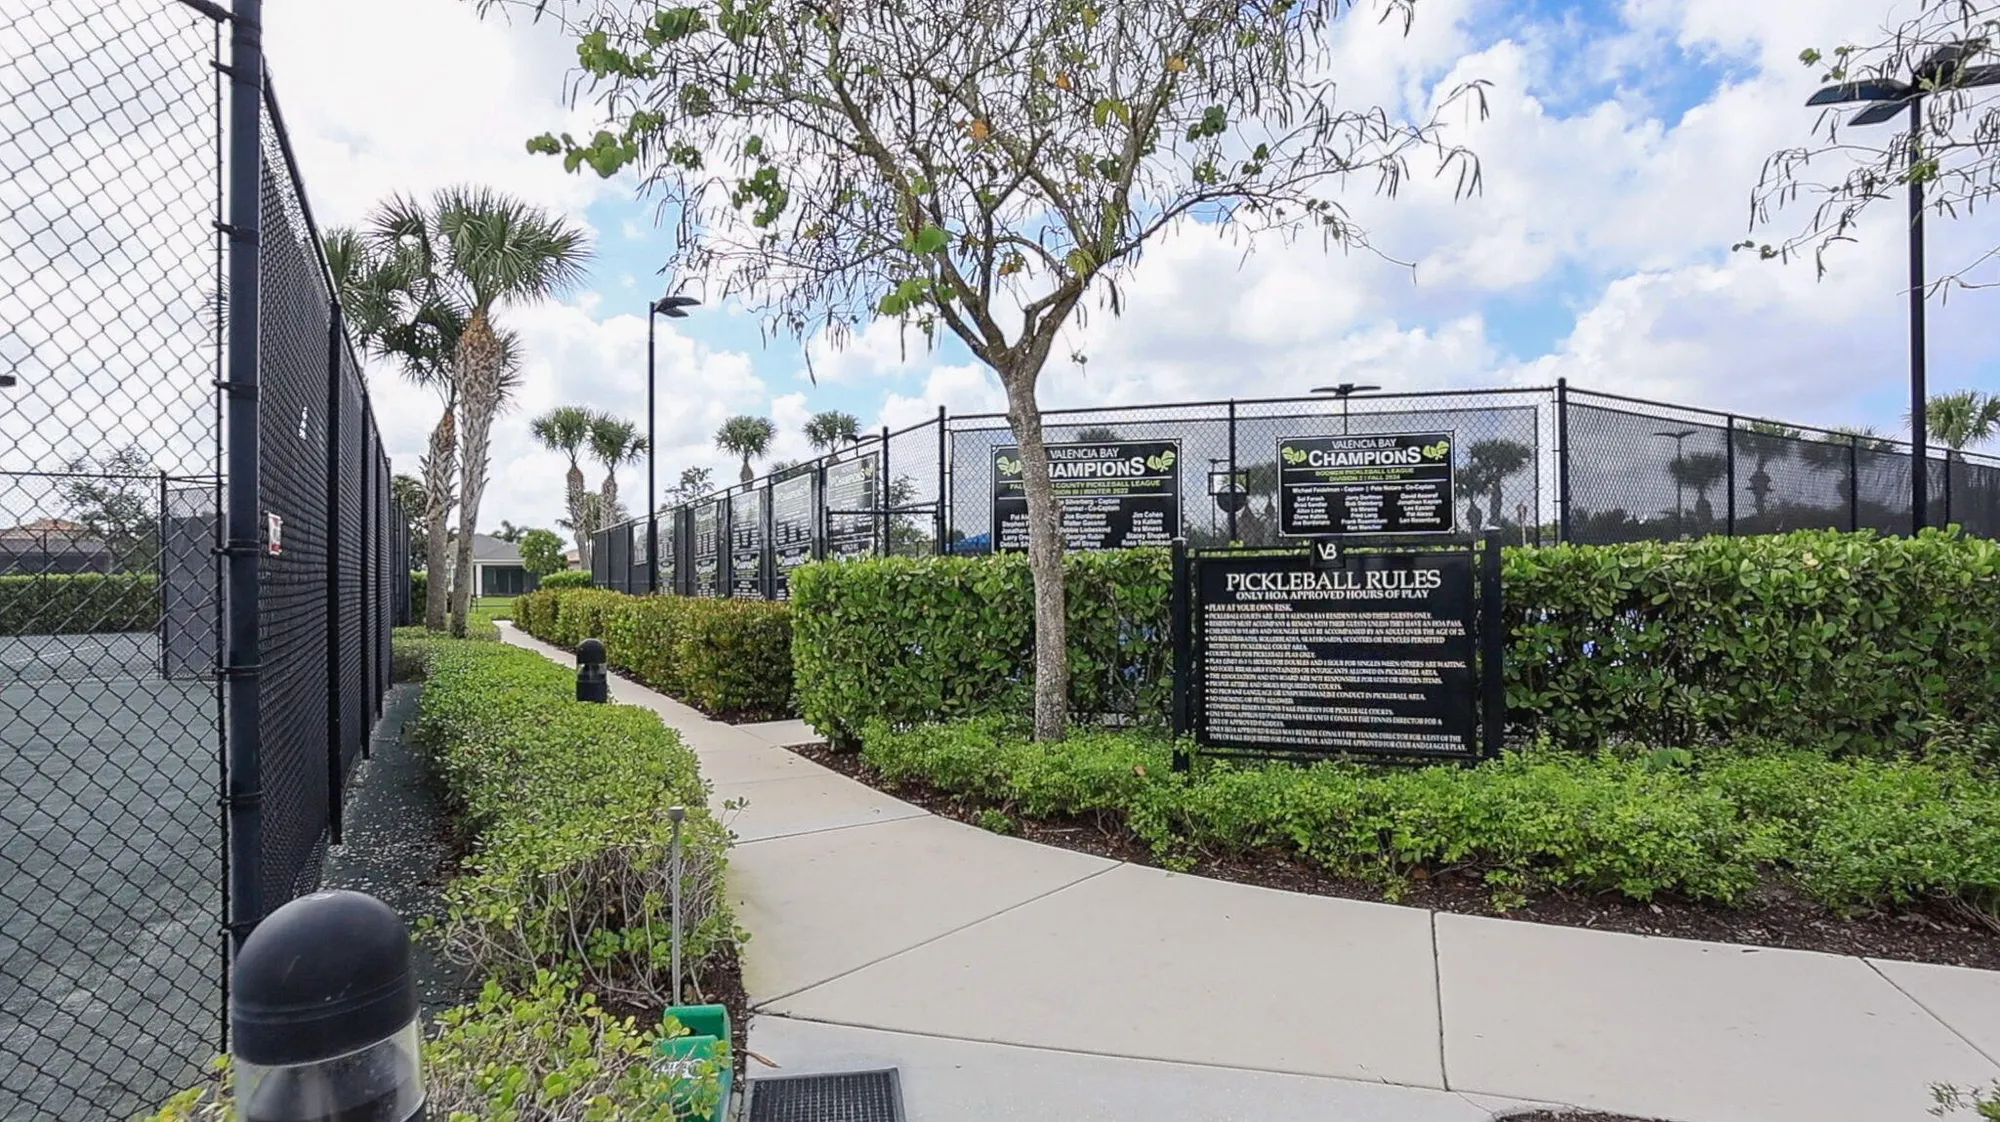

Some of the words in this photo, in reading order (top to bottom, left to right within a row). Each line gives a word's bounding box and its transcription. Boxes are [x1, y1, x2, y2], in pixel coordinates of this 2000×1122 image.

[1332, 439, 1377, 449] VALENCIA
[1378, 438, 1396, 448] BAY
[1050, 448, 1098, 459] VALENCIA
[1100, 447, 1120, 458] BAY
[1308, 447, 1421, 466] CHAMPIONS
[1345, 468, 1385, 476] PICKLEBALL
[1086, 480, 1130, 488] PICKLEBALL
[1131, 479, 1160, 487] LEAGUE
[1226, 571, 1361, 592] PICKLEBALL
[1365, 569, 1442, 590] RULES
[1236, 591, 1265, 600] ONLY
[1265, 590, 1288, 600] HOA
[1290, 590, 1344, 600] APPROVED
[1346, 590, 1384, 600] HOURS
[1384, 590, 1400, 599] OF
[1401, 590, 1430, 599] PLAY
[1237, 603, 1255, 611] YOUR
[1256, 603, 1273, 611] OWN
